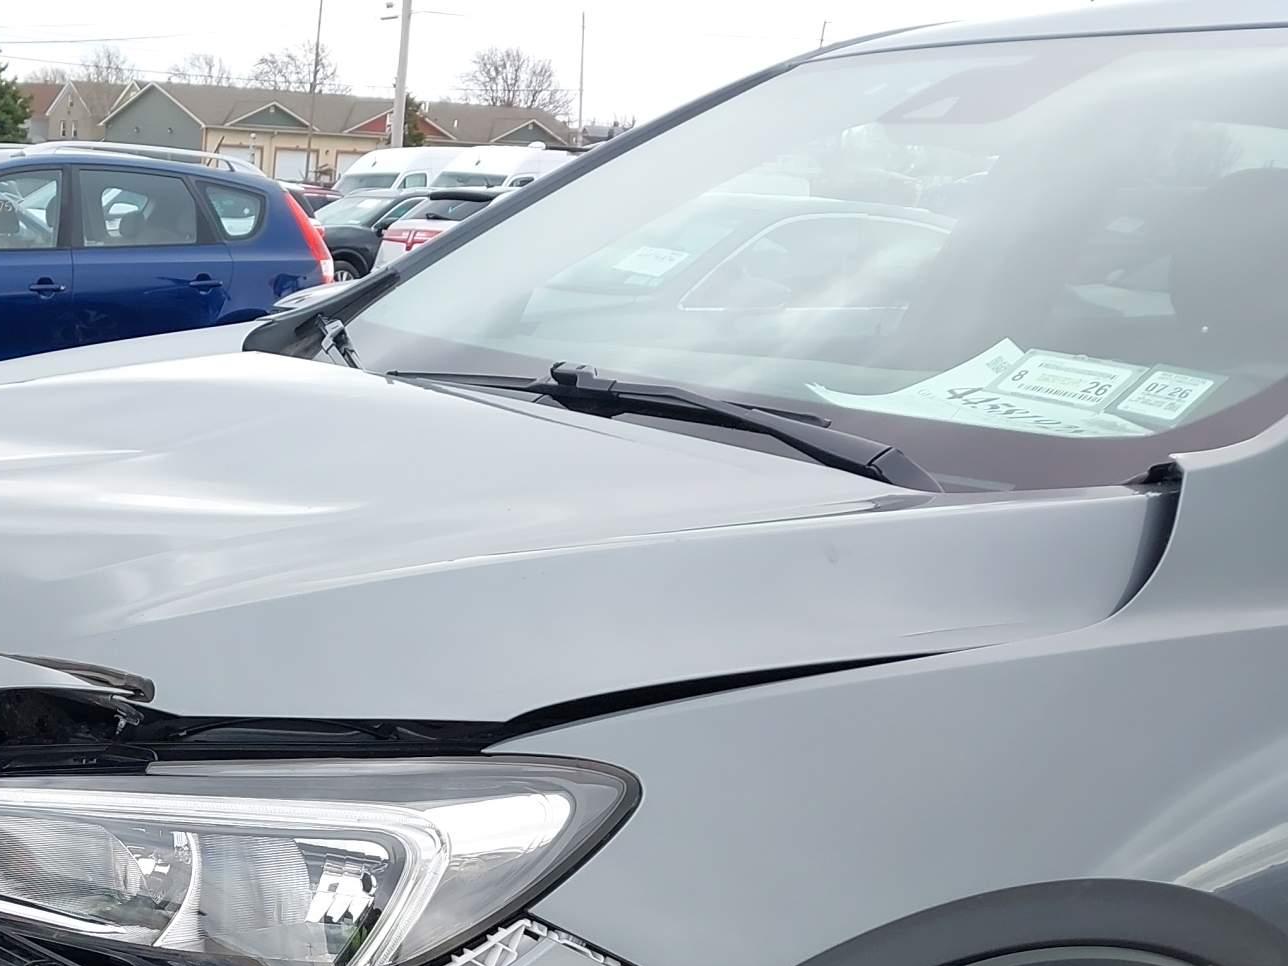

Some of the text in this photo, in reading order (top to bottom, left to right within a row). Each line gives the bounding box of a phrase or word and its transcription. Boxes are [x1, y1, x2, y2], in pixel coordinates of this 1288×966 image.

[1011, 369, 1029, 382] 8
[1081, 381, 1113, 397] 26
[1145, 382, 1192, 399] 07 26
